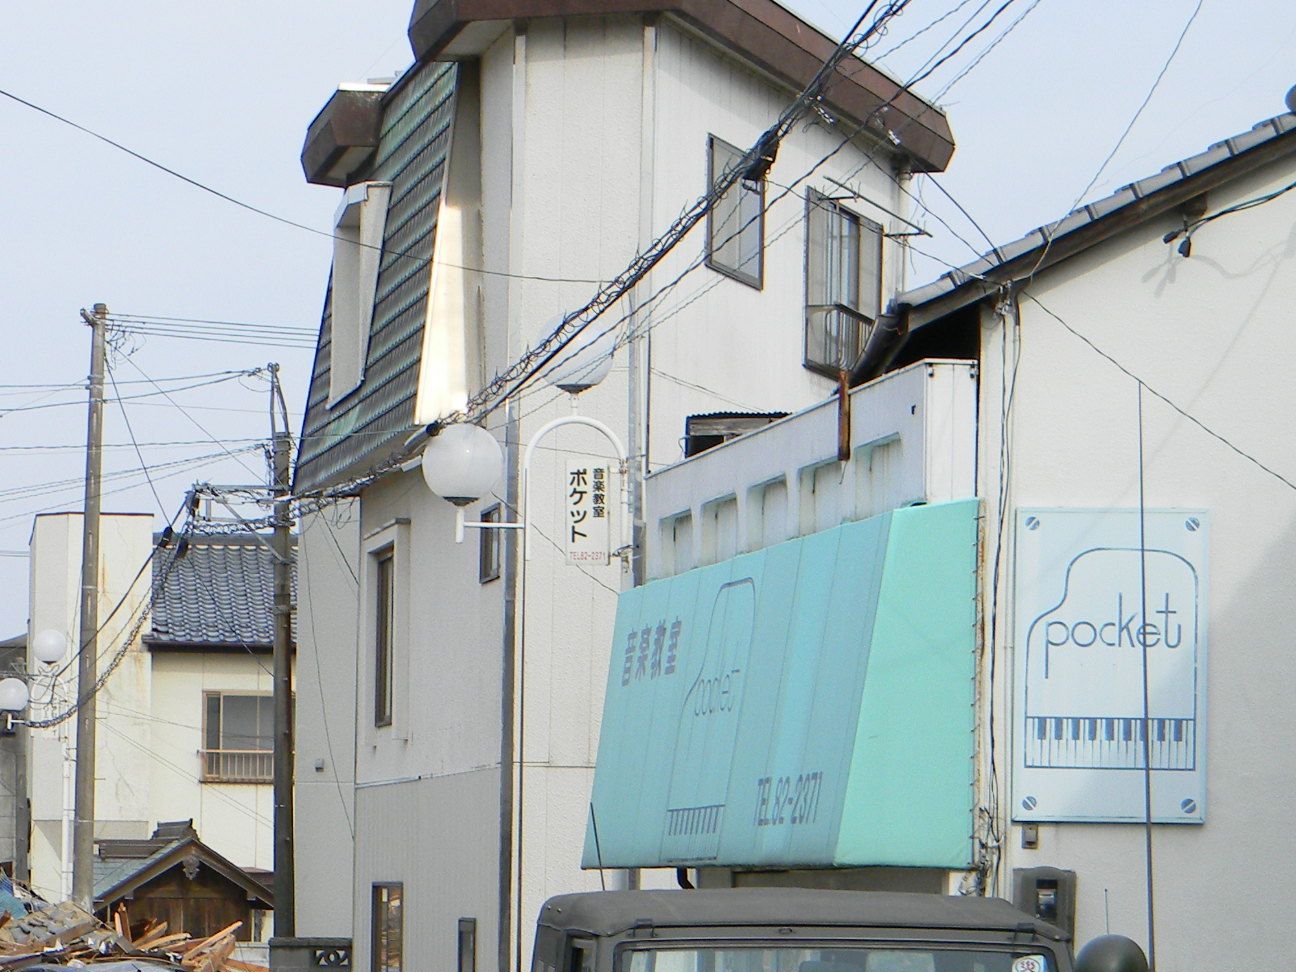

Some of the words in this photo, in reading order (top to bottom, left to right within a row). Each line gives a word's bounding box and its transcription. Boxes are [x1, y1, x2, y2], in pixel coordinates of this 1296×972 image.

[569, 468, 588, 543] ポケット
[593, 468, 606, 518] 音楽教室
[621, 615, 682, 687] 音楽教室
[1044, 592, 1182, 679] pocket
